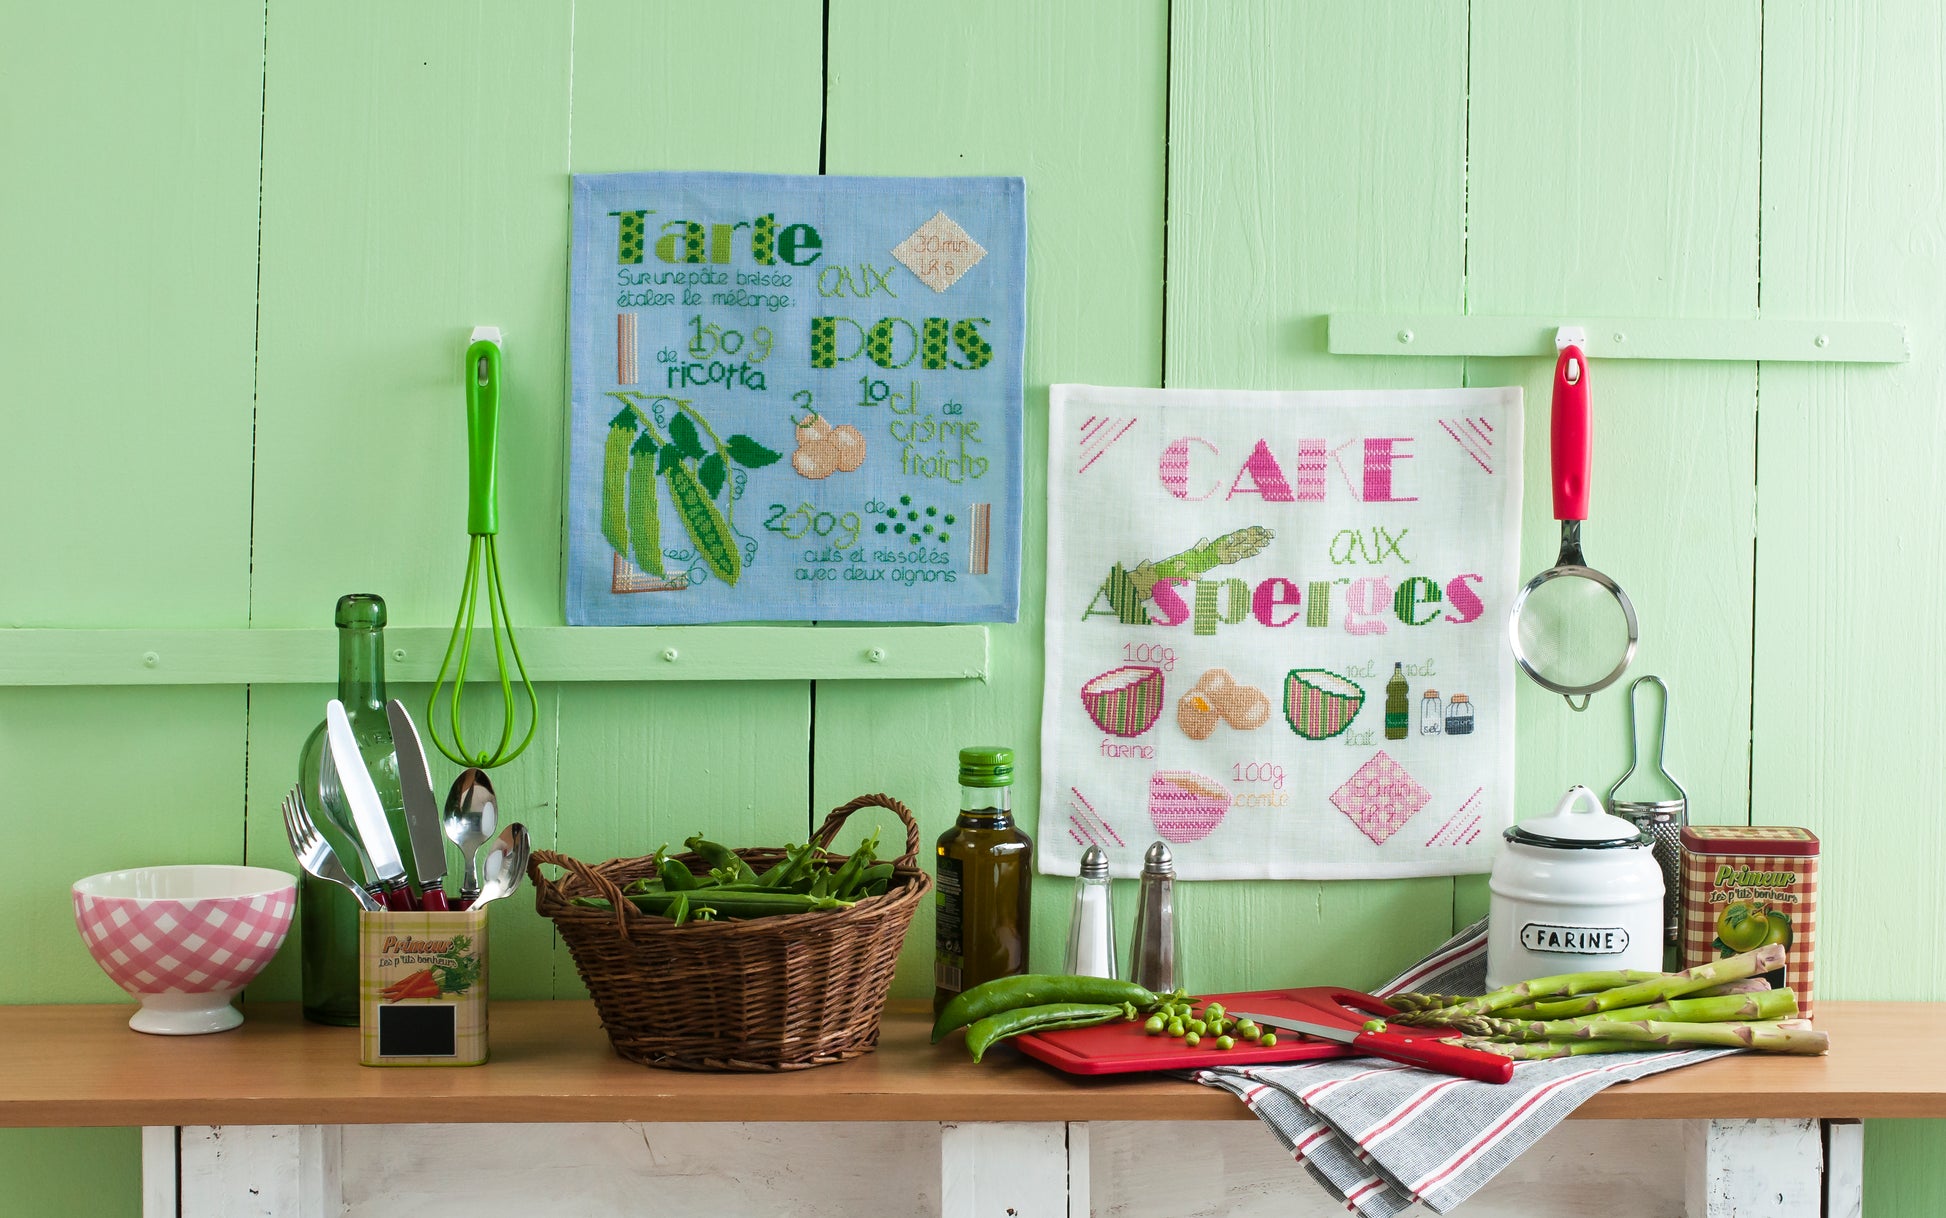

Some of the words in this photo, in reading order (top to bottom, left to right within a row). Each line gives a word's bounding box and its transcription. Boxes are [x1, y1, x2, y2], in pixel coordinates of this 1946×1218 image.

[608, 209, 822, 266] Tarte
[653, 272, 687, 285] une
[688, 266, 727, 290] pâte
[736, 266, 792, 287] brisée
[818, 263, 898, 298] aux
[682, 289, 701, 306] le
[656, 346, 678, 363] de
[668, 360, 767, 391] ricotta
[942, 399, 963, 416] de
[1159, 437, 1418, 502] CAKE
[864, 497, 887, 514] de
[803, 548, 843, 563] cuits
[850, 546, 866, 563] et
[1329, 526, 1410, 564] aux
[794, 567, 837, 581] avec
[843, 564, 886, 581] deux
[891, 565, 957, 586] oignons
[1081, 561, 1485, 636] Asperges
[1122, 642, 1179, 672] 100g
[1099, 738, 1155, 760] farine
[1232, 762, 1288, 790] 100g
[1714, 865, 1797, 887] Primeur
[1709, 891, 1727, 904] Les
[1753, 888, 1799, 904] bonheurs
[382, 935, 455, 954] Primeur
[1536, 929, 1615, 950] FARINE
